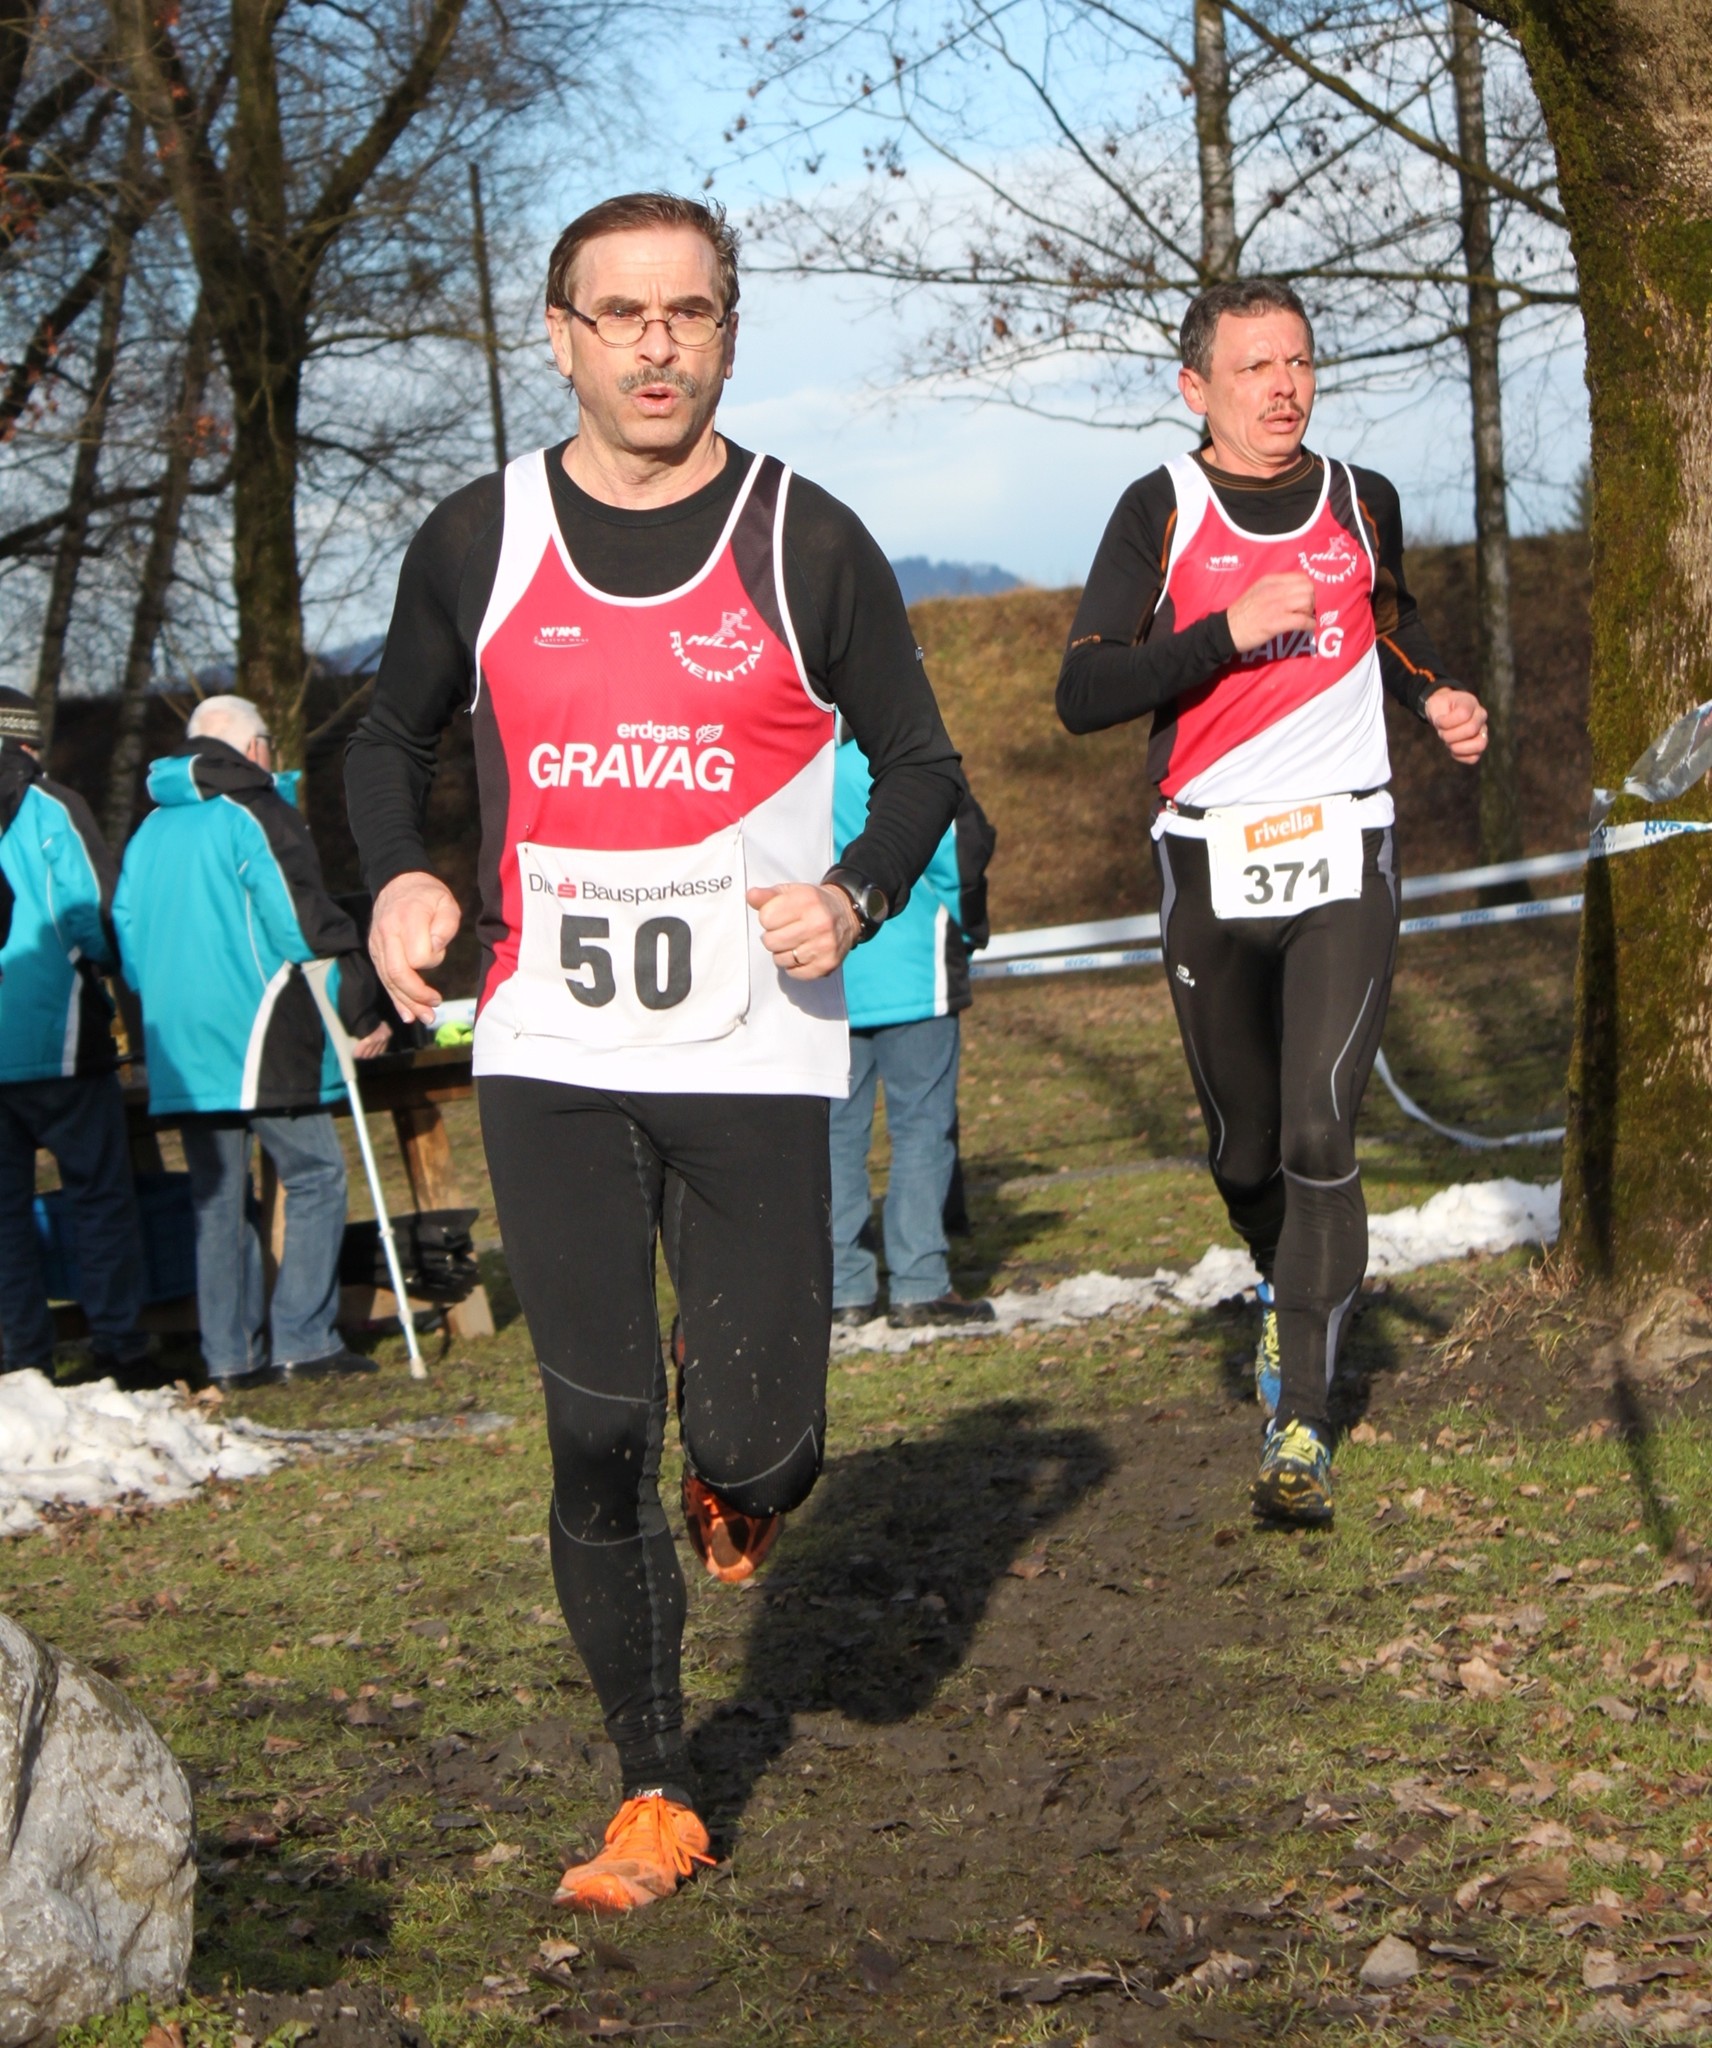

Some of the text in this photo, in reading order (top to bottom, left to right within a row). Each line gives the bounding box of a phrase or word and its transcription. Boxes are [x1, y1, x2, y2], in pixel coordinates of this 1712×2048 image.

[1297, 552, 1358, 584] RHEINTAL
[669, 630, 764, 683] RHEINTAL
[616, 720, 691, 744] erdgas
[528, 742, 736, 793] GRAVAG
[1253, 810, 1315, 845] rivella
[582, 874, 733, 906] Bausparkasse
[1243, 857, 1330, 905] 371
[560, 913, 692, 1011] 50
